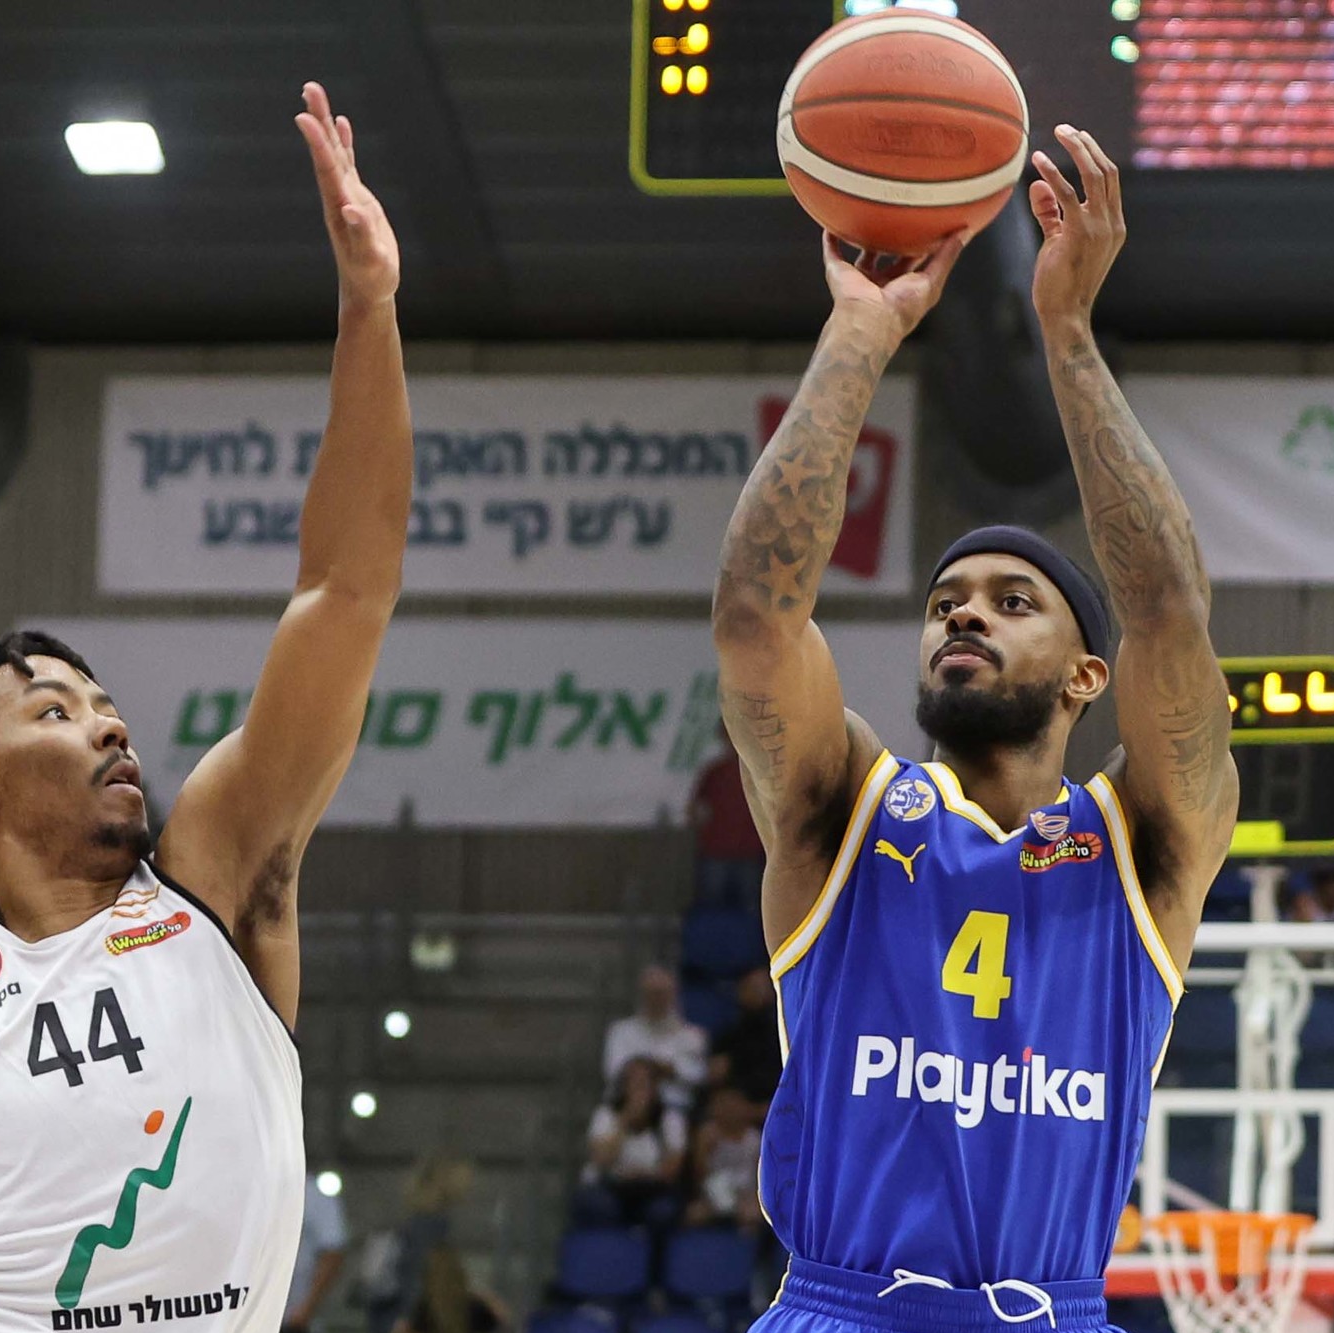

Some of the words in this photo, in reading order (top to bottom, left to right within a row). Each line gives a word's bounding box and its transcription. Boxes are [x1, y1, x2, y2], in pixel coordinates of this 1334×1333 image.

[543, 422, 750, 477] המכללה
[468, 671, 666, 765] אלוף
[114, 928, 167, 949] Winner
[941, 910, 1011, 1019] 4
[27, 987, 145, 1087] 44
[852, 1035, 1105, 1129] Playtika
[51, 1304, 122, 1331] שחם
[128, 1283, 250, 1324] לטשולר
